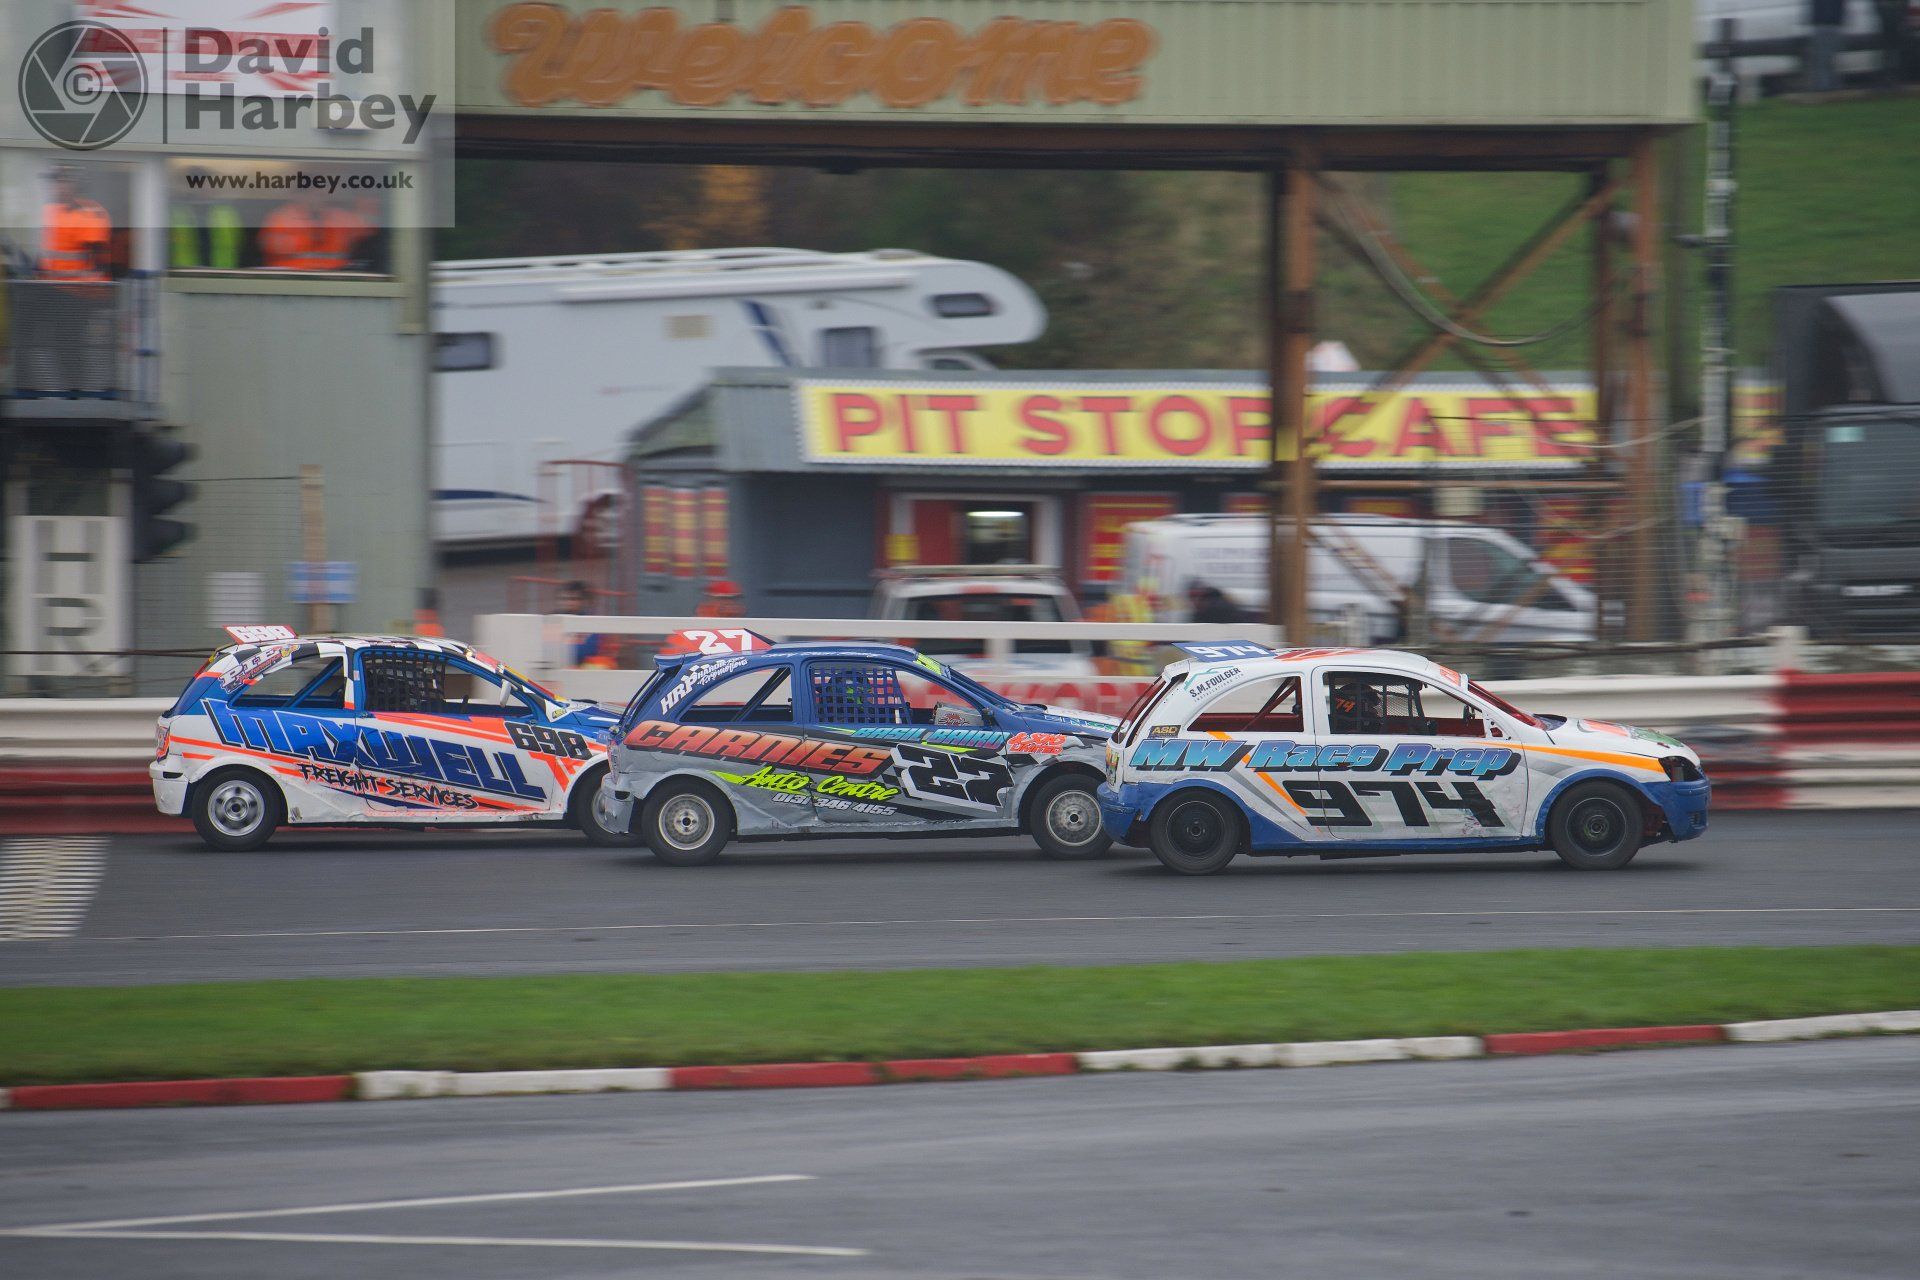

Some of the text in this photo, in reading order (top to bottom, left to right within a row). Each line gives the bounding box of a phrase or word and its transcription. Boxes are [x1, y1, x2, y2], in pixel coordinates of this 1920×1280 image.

[486, 2, 1156, 108] Welcome
[831, 393, 1592, 456] PIT STOP CAFE
[226, 626, 296, 642] 698
[683, 629, 752, 655] 27
[1184, 645, 1270, 658] 974
[660, 672, 698, 715] HRP
[200, 699, 547, 802] MAXWELL
[503, 721, 593, 760] 698
[623, 720, 894, 775] CARNIES
[851, 728, 1011, 749] BASIL BAIRD
[1129, 739, 1516, 777] MW Race Prep
[298, 763, 479, 809] FREIGHT SERVICES
[742, 766, 899, 801] Auto Centre
[894, 743, 1014, 808] 27
[772, 792, 898, 817] 0131 346 4155
[1282, 780, 1506, 827] 974
